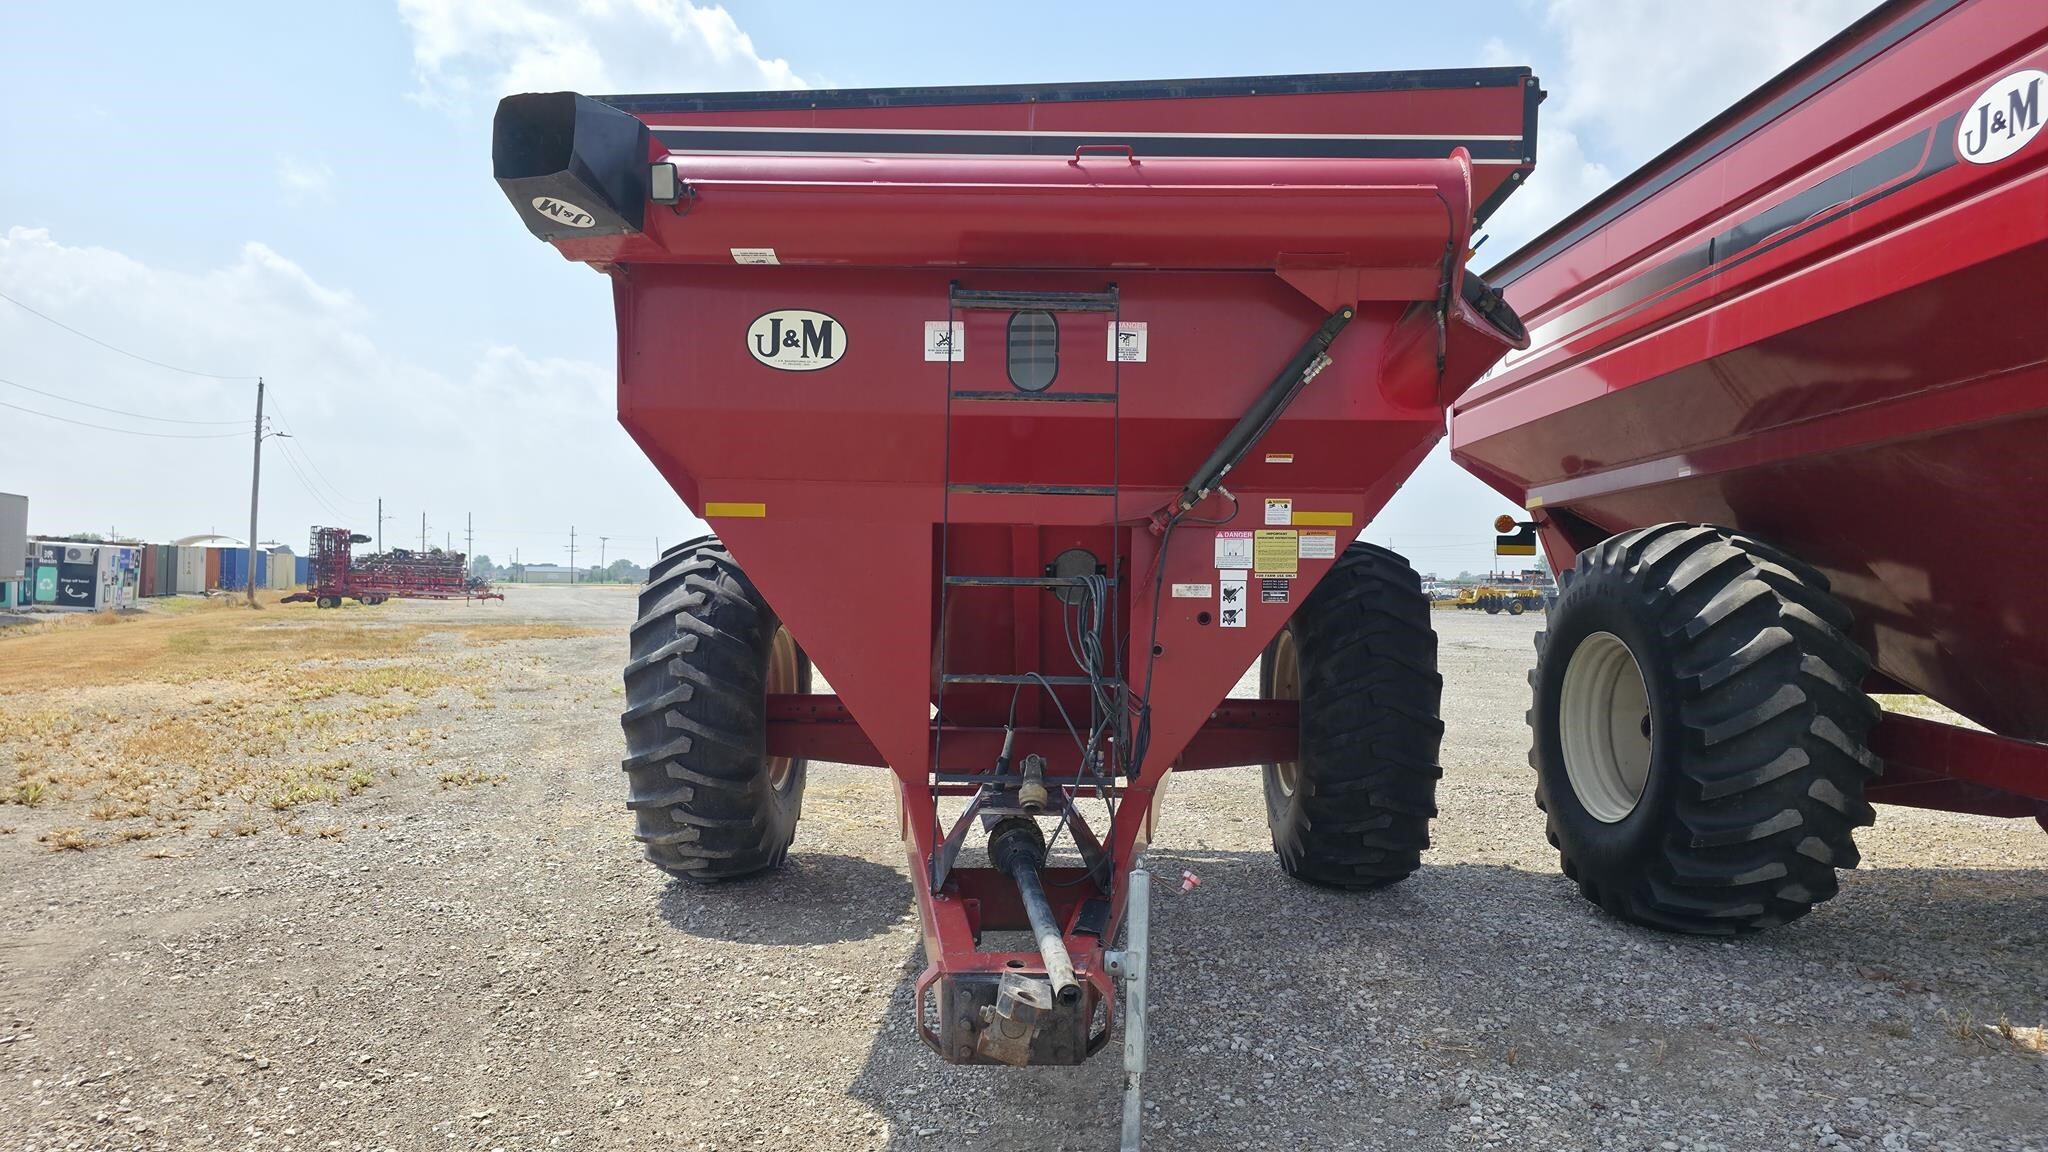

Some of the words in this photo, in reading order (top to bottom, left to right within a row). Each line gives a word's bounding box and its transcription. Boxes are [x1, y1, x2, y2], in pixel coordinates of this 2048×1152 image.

[1964, 77, 2041, 156] J&M
[538, 198, 593, 225] J&M
[754, 318, 835, 359] J&M
